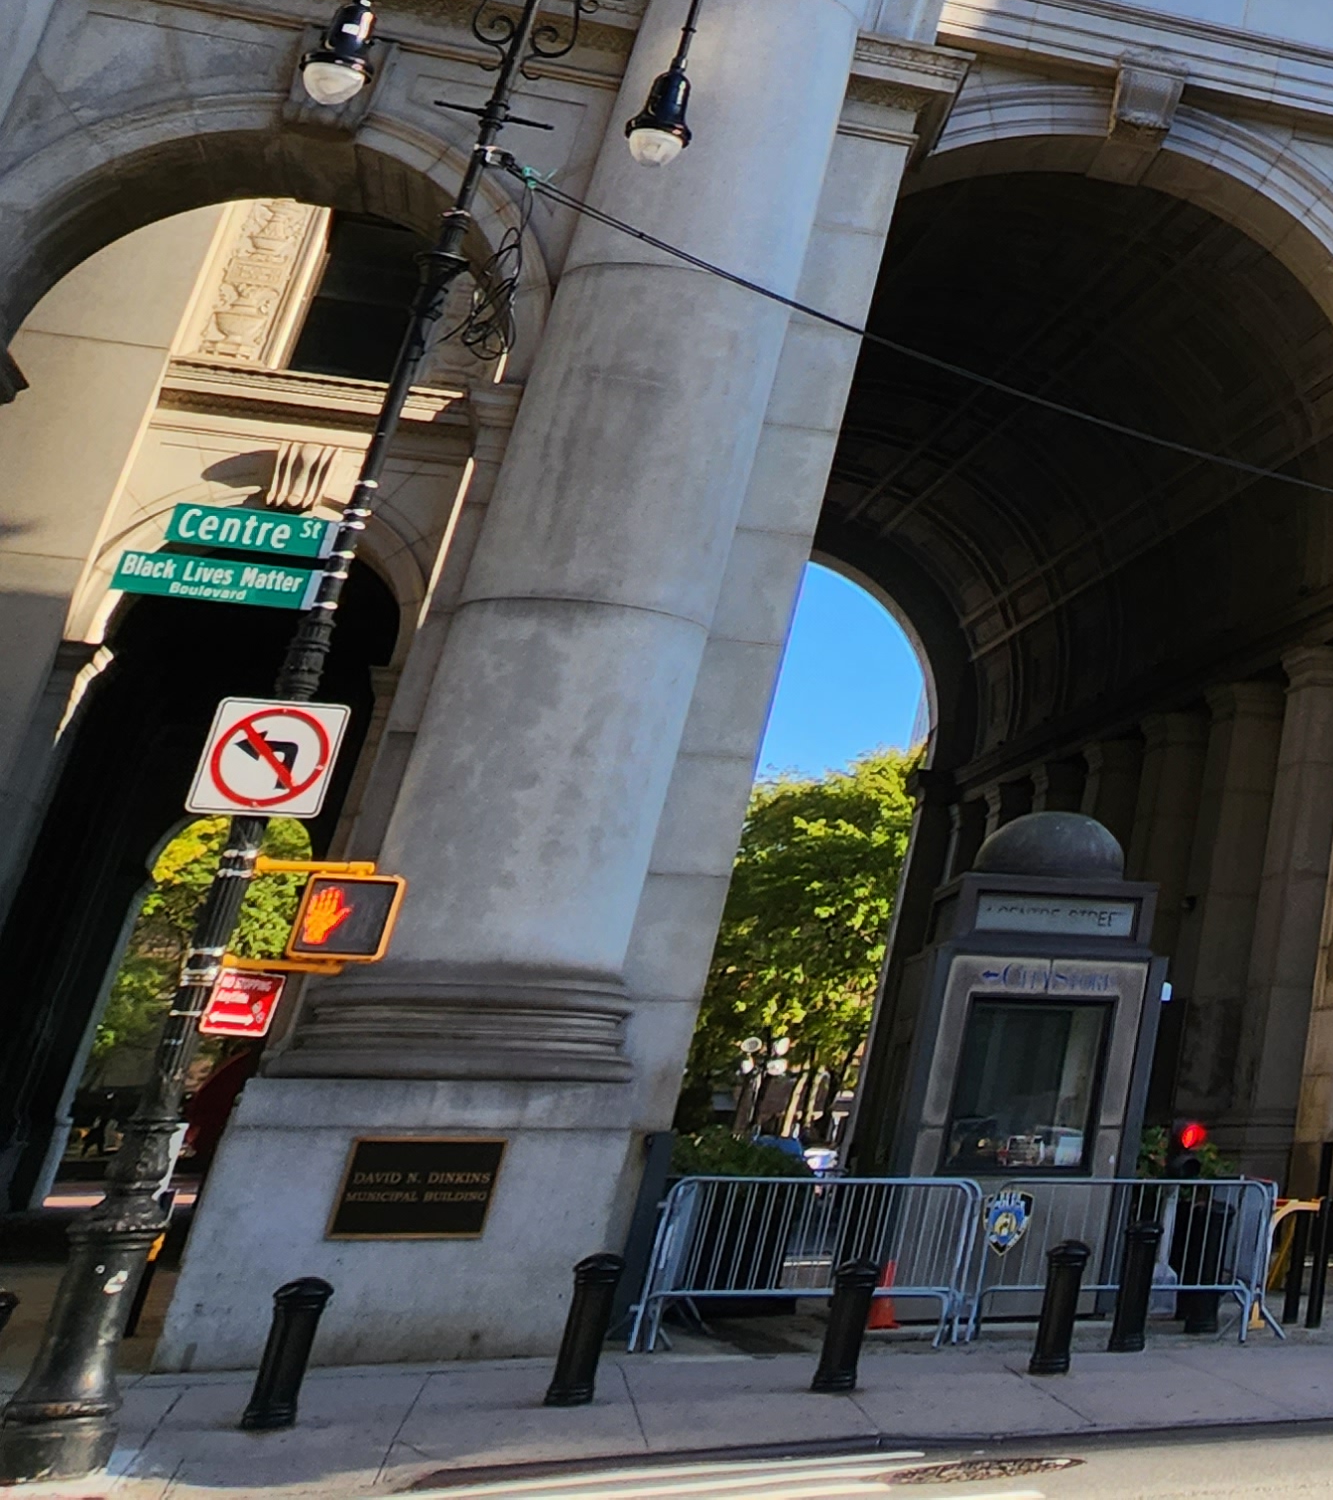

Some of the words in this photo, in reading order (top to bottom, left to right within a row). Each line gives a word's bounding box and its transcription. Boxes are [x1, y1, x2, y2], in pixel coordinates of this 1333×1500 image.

[178, 508, 292, 548] Centre
[300, 520, 322, 539] St
[121, 553, 177, 580] Black
[182, 560, 234, 586] Lives
[240, 566, 304, 593] Matter
[168, 581, 248, 601] Boulevard
[353, 1172, 402, 1184] DAVID
[406, 1172, 421, 1184] N.
[427, 1172, 491, 1184] DINKINS
[345, 1191, 418, 1202] MUNICIPAL
[423, 1191, 487, 1202] BUILDING
